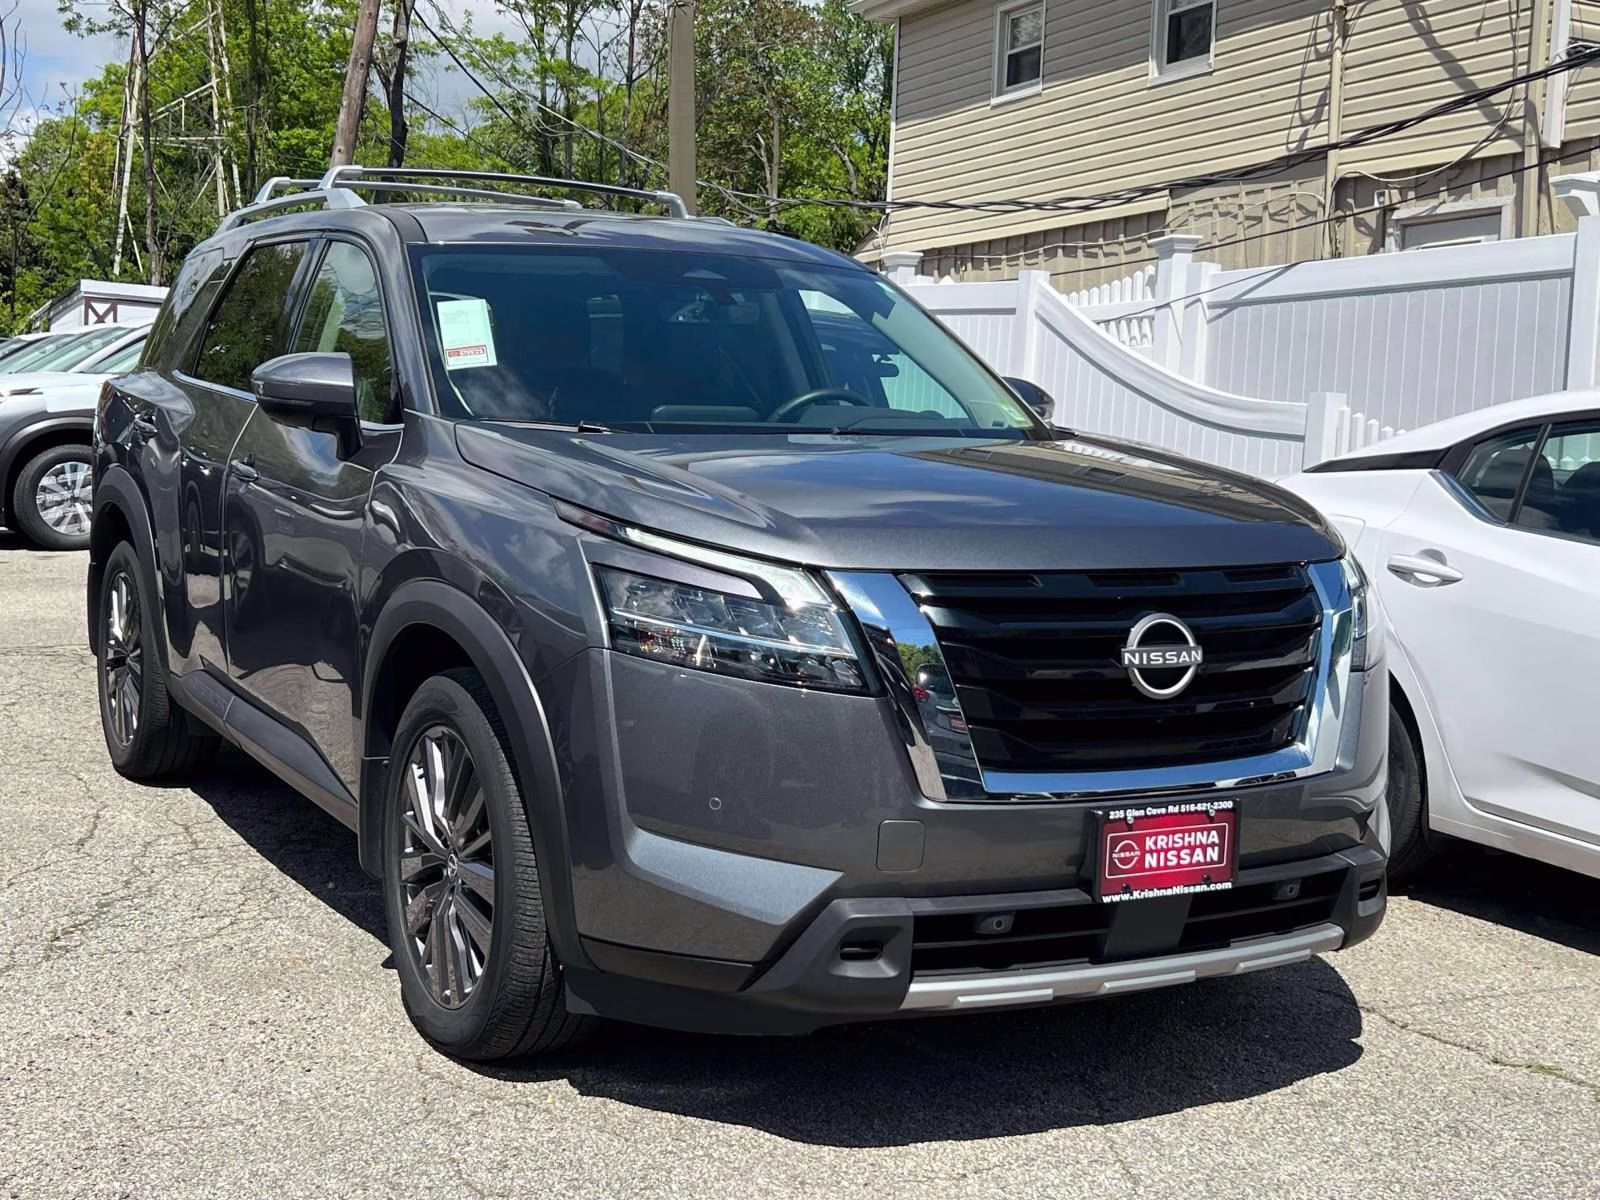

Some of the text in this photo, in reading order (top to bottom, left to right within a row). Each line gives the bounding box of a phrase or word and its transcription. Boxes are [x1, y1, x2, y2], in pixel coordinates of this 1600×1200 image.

[1124, 650, 1201, 664] NISSAN
[1109, 810, 1124, 819] 235
[1146, 806, 1166, 815] Cove
[1168, 805, 1179, 813] Rd
[1145, 830, 1219, 850] KRISHNA
[1112, 850, 1141, 858] NISSAN
[1144, 846, 1218, 868] NISSAN
[1102, 881, 1232, 903] www.KrishnaNissan.com
